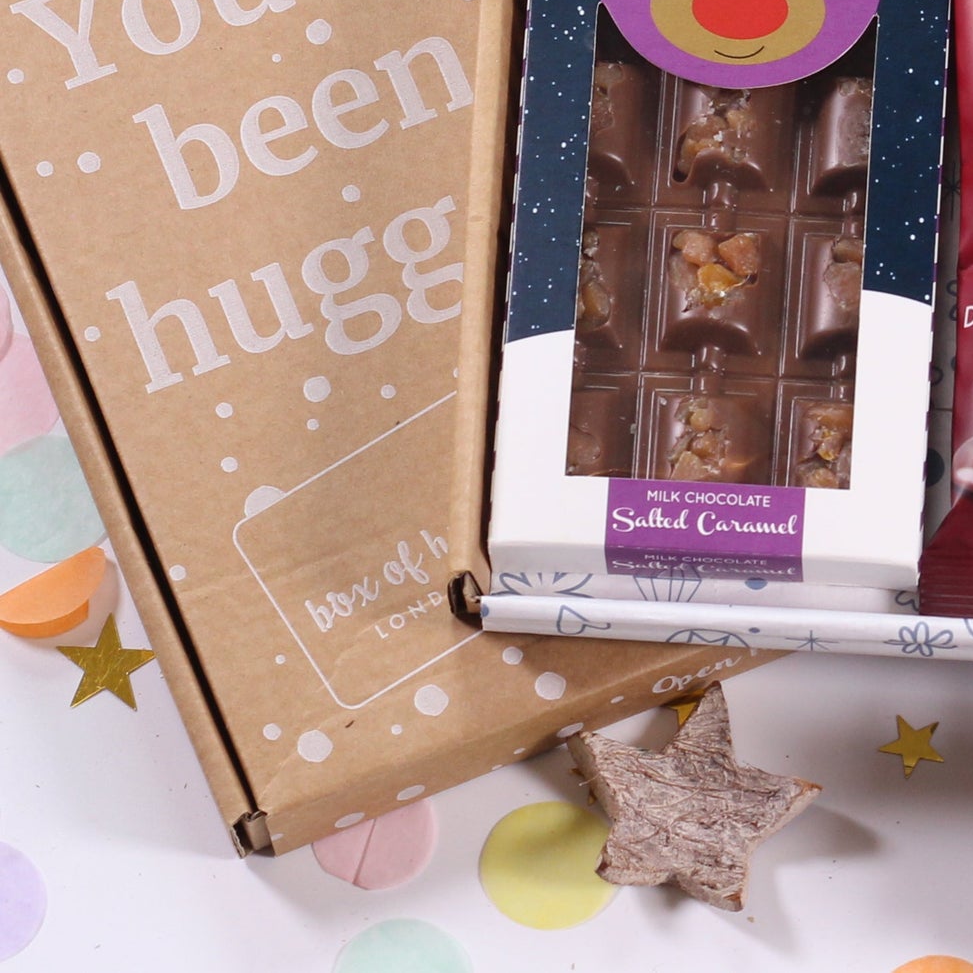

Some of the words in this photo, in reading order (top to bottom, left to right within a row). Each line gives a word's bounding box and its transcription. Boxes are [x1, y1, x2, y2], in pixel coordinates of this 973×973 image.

[133, 36, 474, 210] been
[647, 490, 680, 503] MILK
[685, 492, 771, 507] CHOCOLATE
[612, 507, 689, 532] Salted
[697, 511, 798, 535] Caramel
[612, 560, 688, 571] Salted
[697, 564, 795, 575] Caramel
[682, 557, 767, 565] CHOCOLATE
[305, 576, 379, 632] box
[384, 541, 429, 585] of
[651, 655, 743, 694] Open
